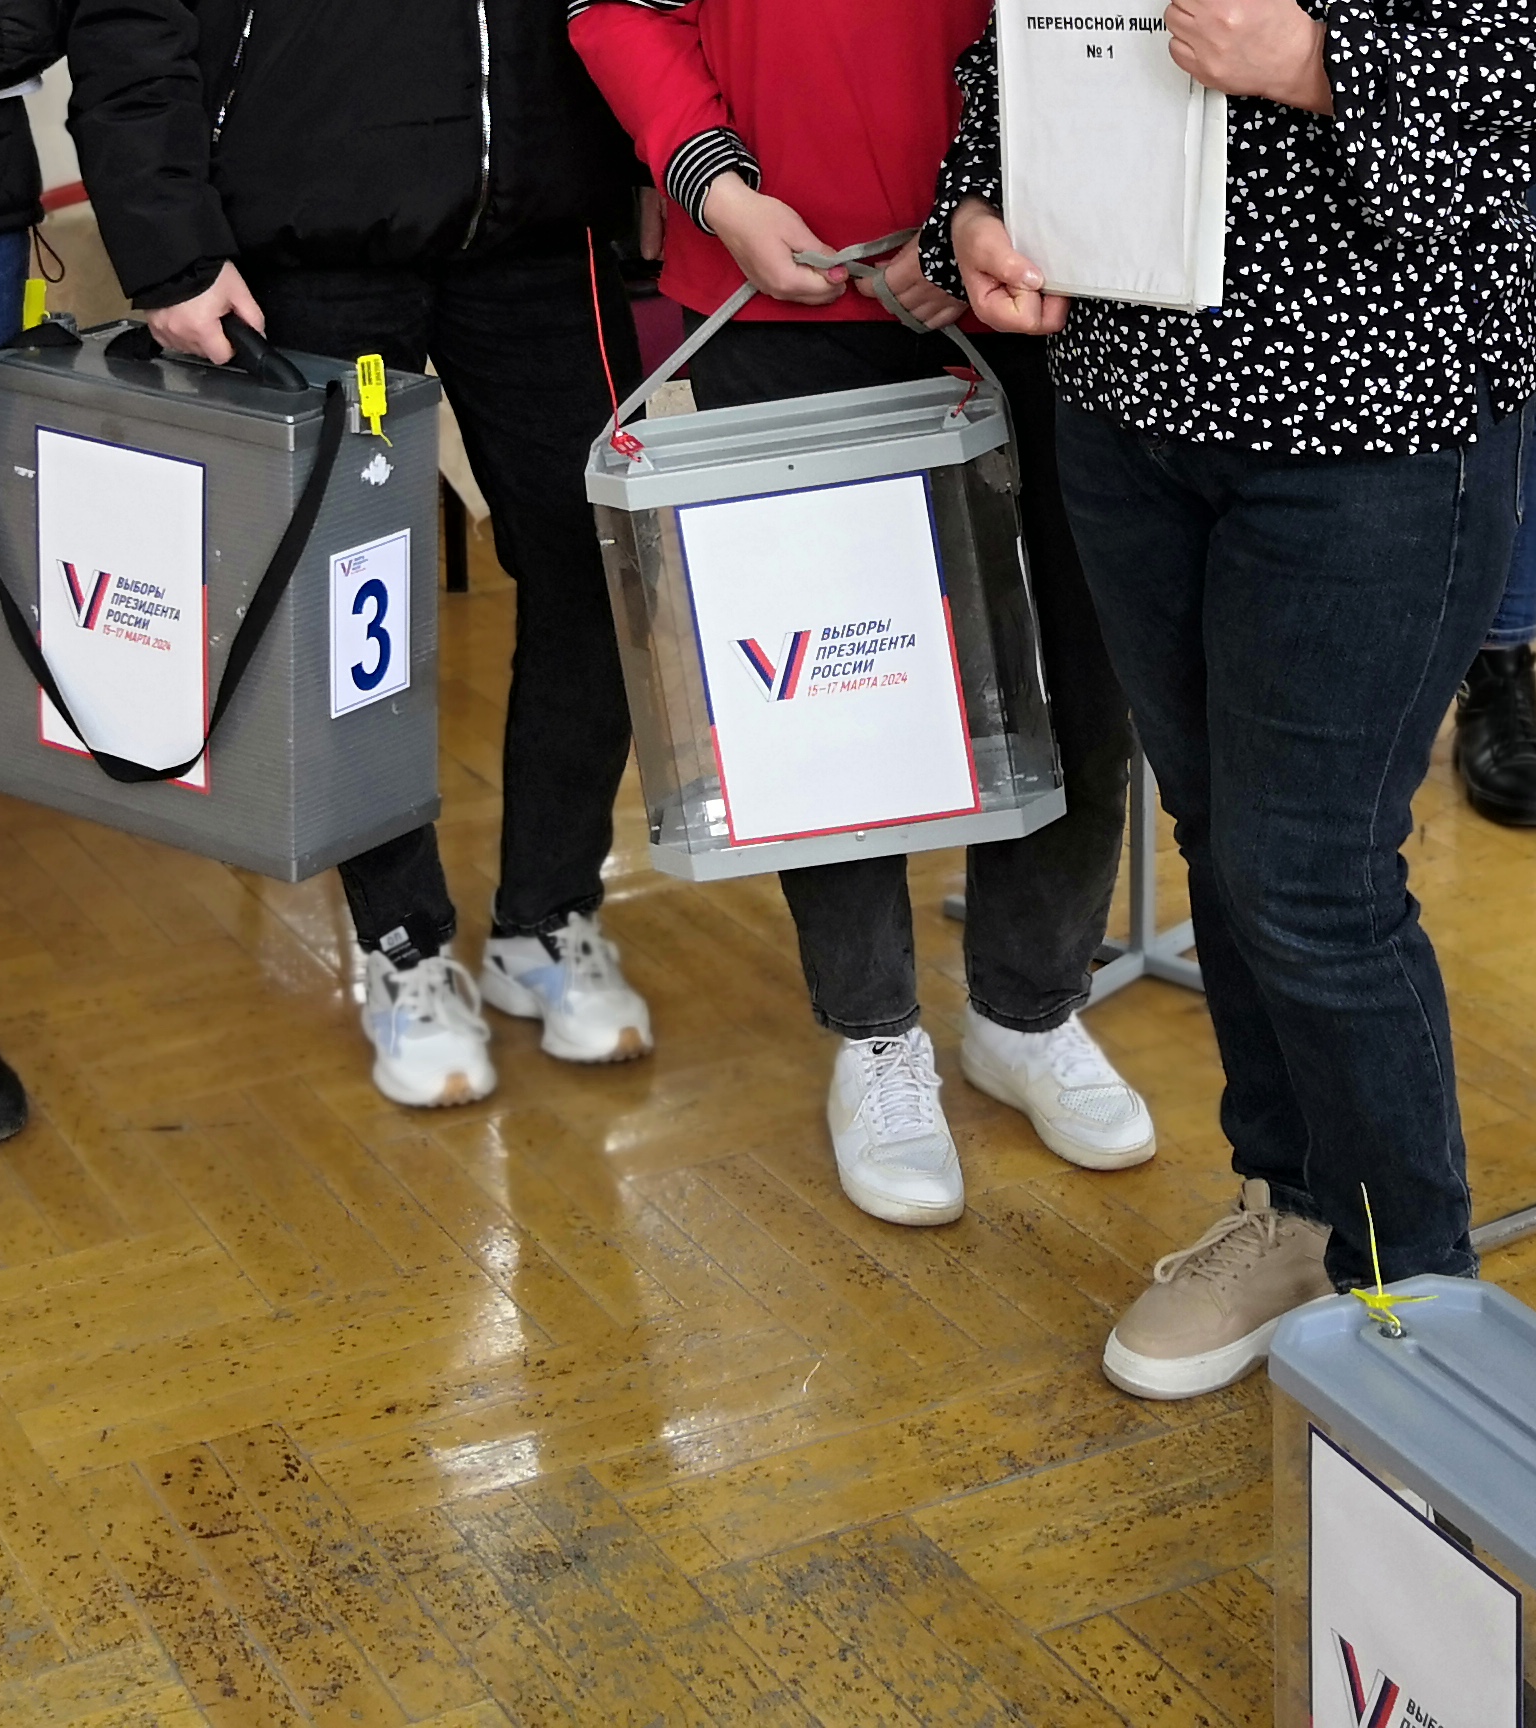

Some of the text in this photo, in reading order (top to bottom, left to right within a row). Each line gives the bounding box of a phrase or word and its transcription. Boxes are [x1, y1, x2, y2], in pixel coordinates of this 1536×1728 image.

[1027, 14, 1125, 31] ПЕРЕНОСНОЙ
[1086, 44, 1114, 59] № 1
[116, 576, 166, 599] ВЫБОРЫ
[111, 593, 181, 621] ПРЕЗИДЕНТА
[106, 609, 151, 630] РОССИИ
[821, 618, 892, 641] ВЫБОРЫ
[350, 578, 392, 691] 3
[815, 633, 916, 660] ПРЕЗИДЕНТА
[811, 658, 875, 680] РОССИИ
[839, 676, 878, 692] МАРТА
[880, 672, 908, 686] 2024
